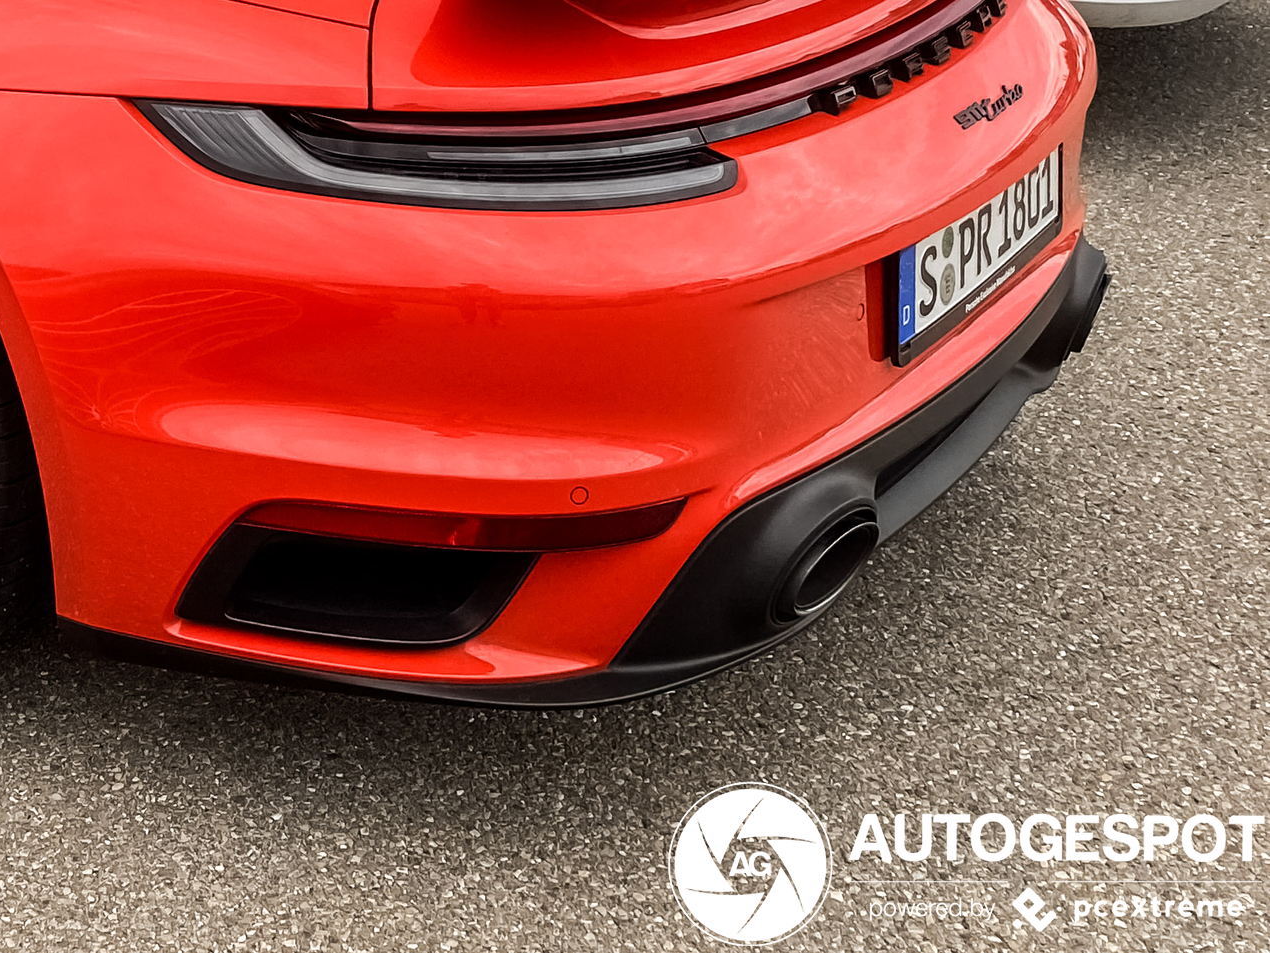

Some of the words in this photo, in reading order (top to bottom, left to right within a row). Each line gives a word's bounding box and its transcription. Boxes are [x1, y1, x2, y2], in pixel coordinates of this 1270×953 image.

[919, 245, 938, 317] S
[959, 203, 992, 289] PR
[998, 154, 1054, 258] 1801
[903, 305, 911, 326] D
